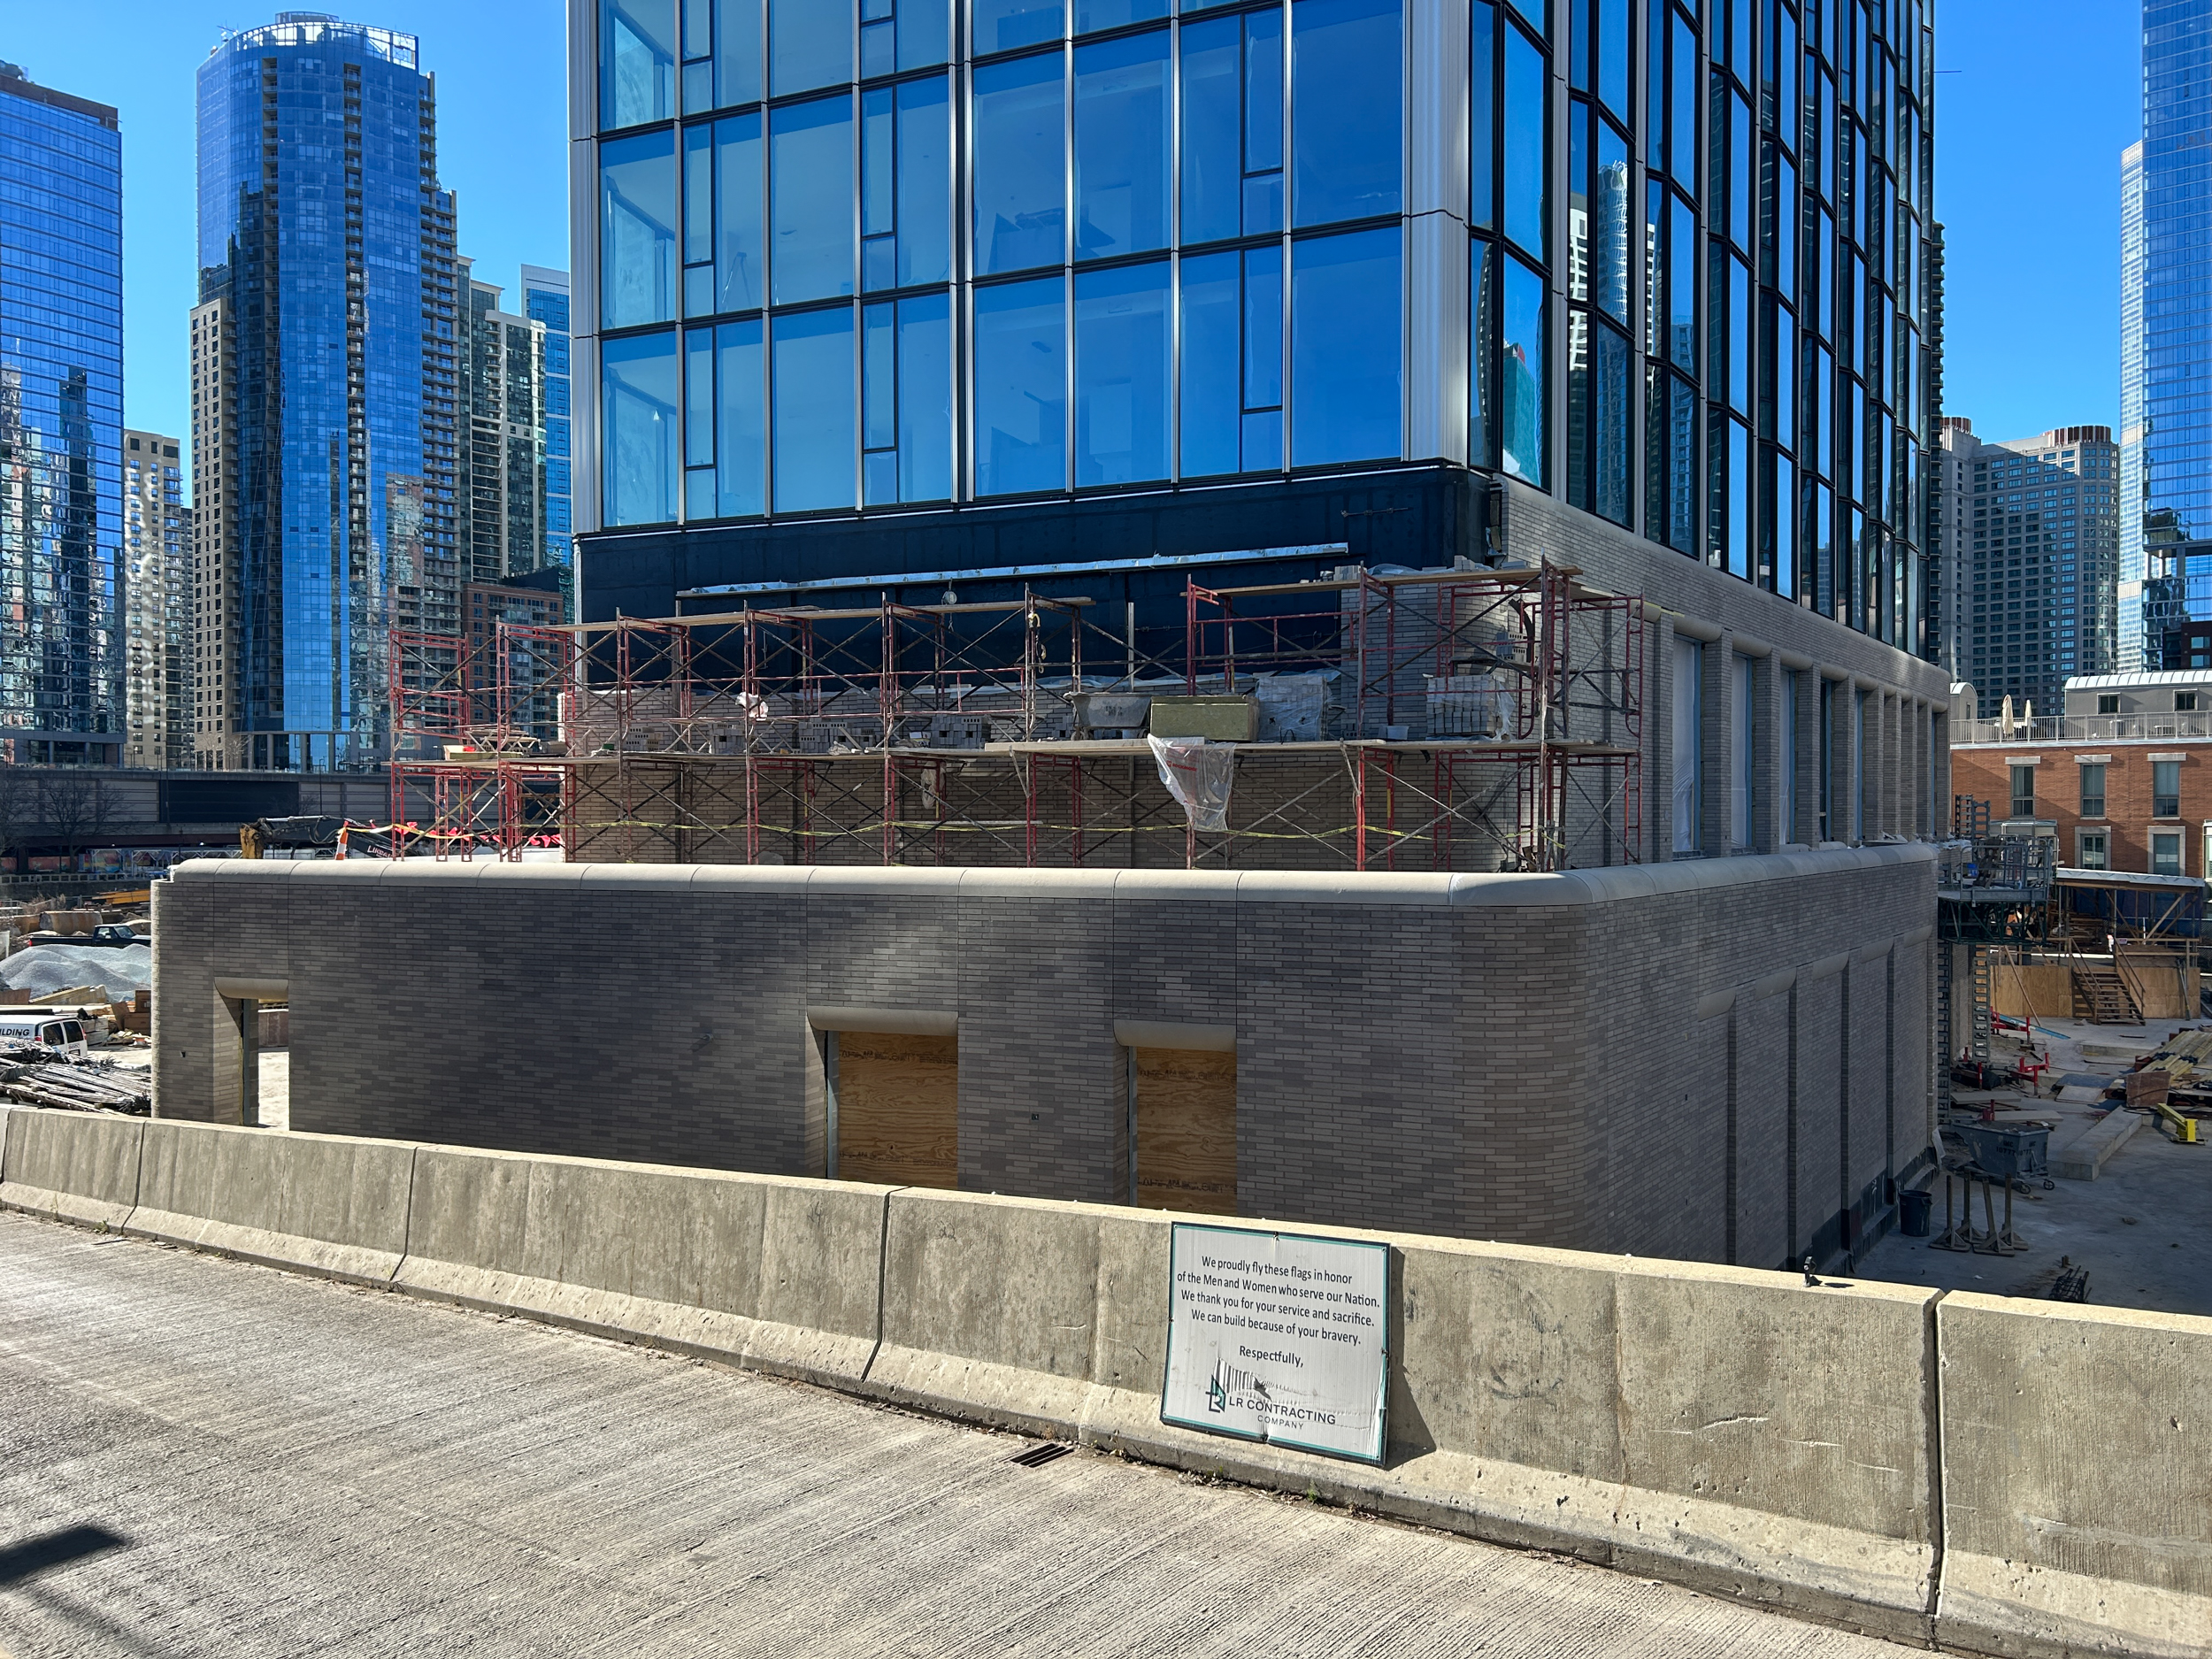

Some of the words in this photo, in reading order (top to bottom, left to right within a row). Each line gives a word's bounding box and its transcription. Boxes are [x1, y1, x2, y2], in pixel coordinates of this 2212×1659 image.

[1202, 1256, 1216, 1267] We
[1217, 1260, 1250, 1274] proudly
[1252, 1261, 1263, 1276] fly
[1264, 1263, 1288, 1277] these
[1291, 1265, 1311, 1281] flags
[1314, 1269, 1323, 1280] in
[1324, 1270, 1352, 1284] honor
[1177, 1271, 1187, 1282] of
[1187, 1272, 1201, 1284] the
[1203, 1274, 1223, 1286] Men
[1224, 1278, 1240, 1288] and
[1242, 1279, 1277, 1294] Women
[1279, 1284, 1298, 1296] who
[1299, 1288, 1324, 1300] serve
[1326, 1292, 1342, 1302] our
[1344, 1292, 1380, 1308] Nation.
[1181, 1289, 1195, 1301] We
[1197, 1291, 1221, 1305] thank
[1223, 1297, 1239, 1309] you
[1240, 1296, 1254, 1310] for
[1256, 1302, 1276, 1313] your
[1278, 1304, 1310, 1317] service
[1312, 1309, 1330, 1320] and
[1333, 1311, 1374, 1326] sacrifice.
[1191, 1309, 1205, 1321] We
[1207, 1313, 1222, 1324] can
[1224, 1313, 1246, 1327] build
[1248, 1317, 1284, 1333] because
[1286, 1323, 1296, 1334] of
[1297, 1326, 1319, 1338] your
[1321, 1327, 1361, 1347] bravery.
[1240, 1345, 1304, 1368] Respectfully,
[1229, 1396, 1243, 1408] LR
[1247, 1399, 1336, 1425] CONTRACTING
[1257, 1415, 1304, 1430] COMPANY
